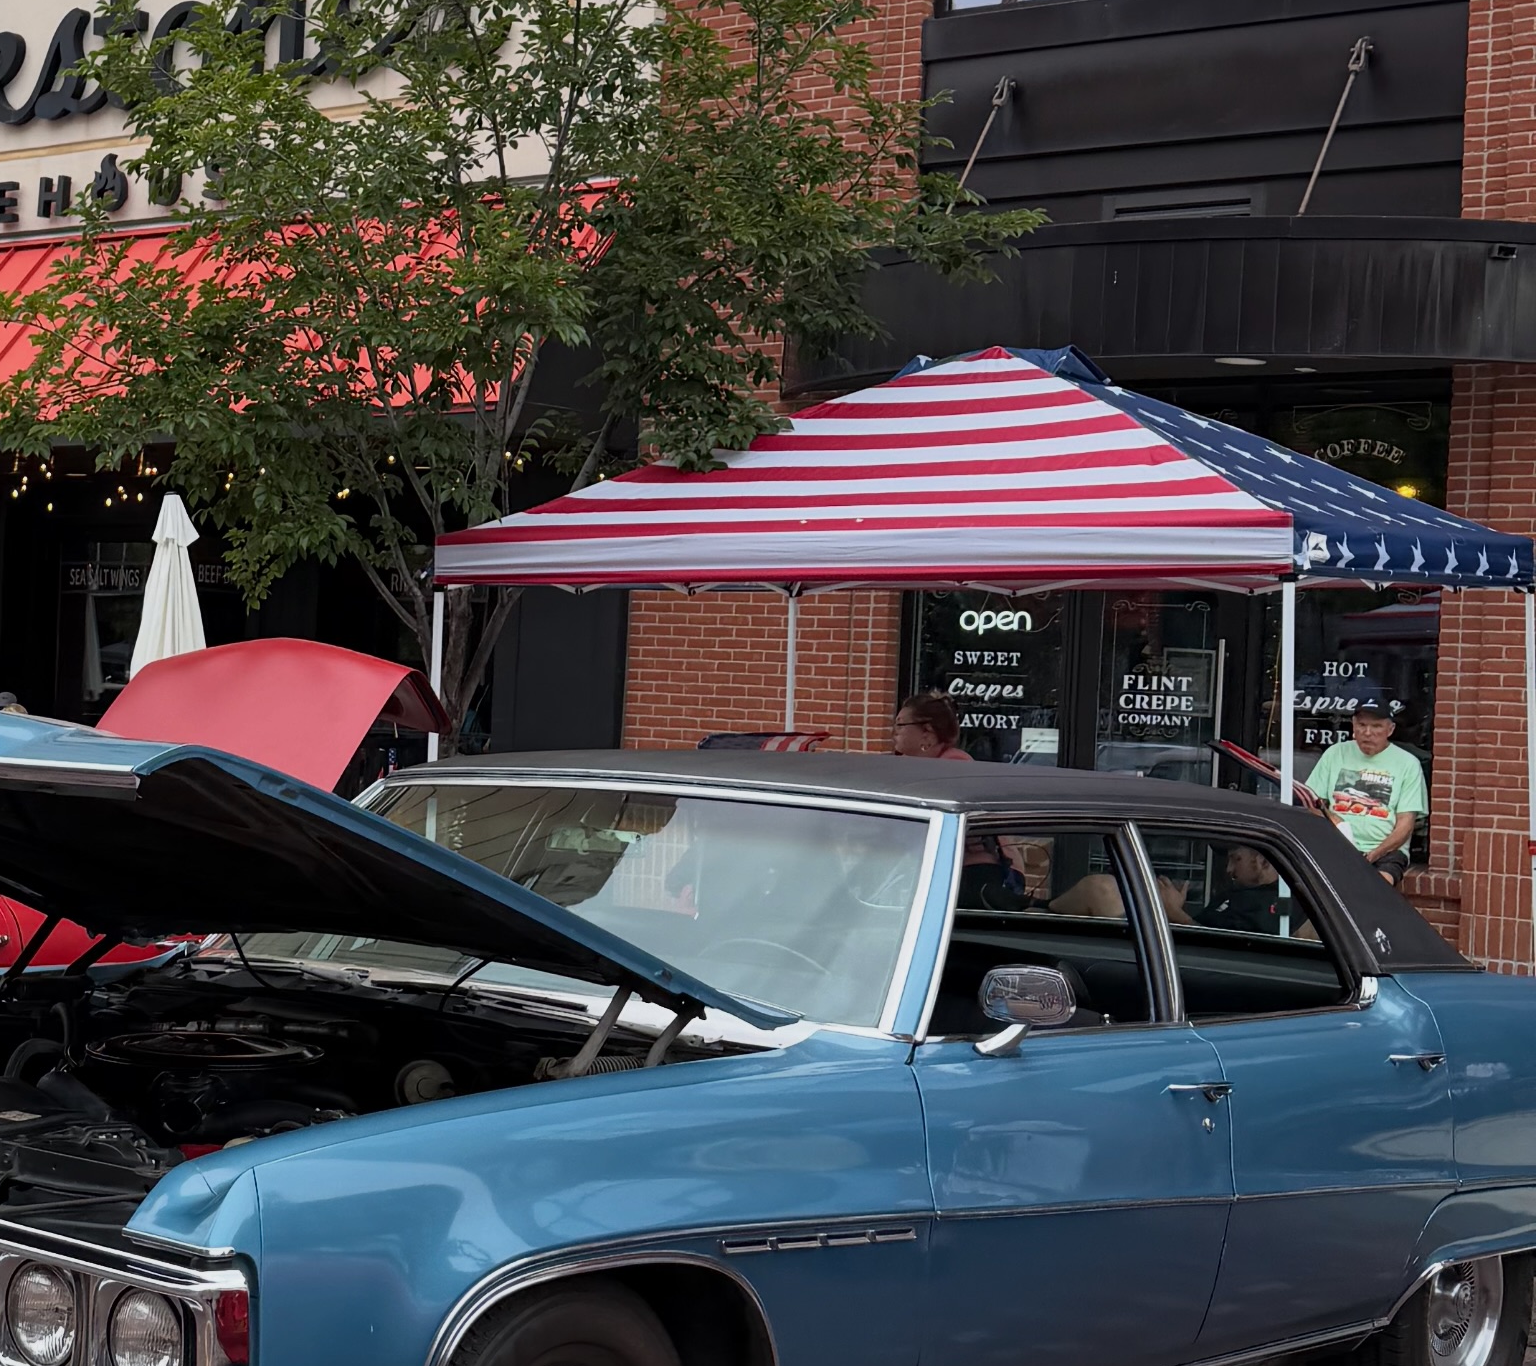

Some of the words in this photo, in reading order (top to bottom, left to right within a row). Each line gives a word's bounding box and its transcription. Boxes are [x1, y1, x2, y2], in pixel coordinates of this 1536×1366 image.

[1314, 438, 1405, 464] COFFEE
[69, 568, 86, 585] SEA
[88, 568, 110, 586] SALT
[110, 568, 140, 587] WINGS
[198, 564, 223, 584] BEEF
[959, 610, 1032, 635] open
[954, 650, 1021, 667] SWEET
[1322, 661, 1368, 678] HOT
[948, 677, 1025, 701] Crepes
[1122, 674, 1193, 692] FLINT
[1119, 693, 1194, 712] CREPE
[959, 712, 1021, 730] AVORY
[1118, 712, 1193, 728] COMPANY
[1304, 728, 1350, 745] FRE
